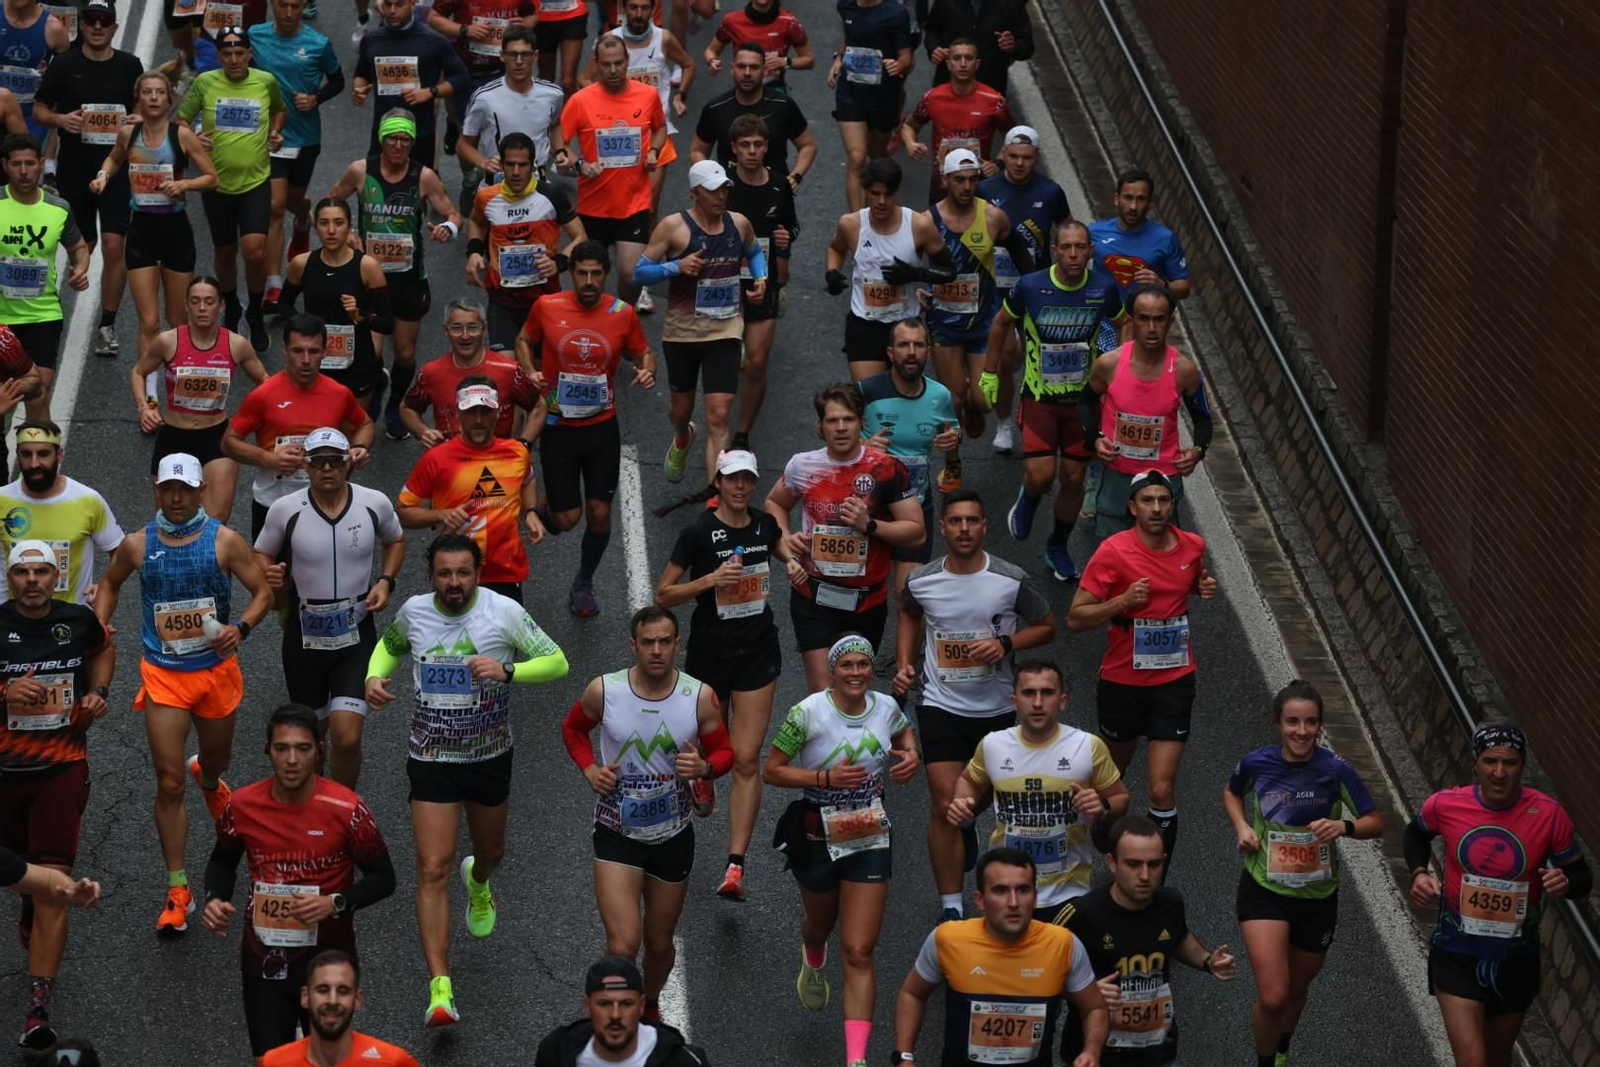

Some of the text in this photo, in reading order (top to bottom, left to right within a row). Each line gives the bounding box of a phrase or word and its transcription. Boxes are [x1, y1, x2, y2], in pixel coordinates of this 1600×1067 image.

[5, 75, 32, 87] 1630
[89, 114, 117, 126] 4064
[222, 108, 251, 121] 2575
[603, 137, 631, 150] 3372
[508, 208, 529, 218] RUN
[507, 225, 530, 235] FUN
[373, 244, 402, 256] 6122
[6, 267, 37, 280] 3089
[704, 288, 734, 301] 2432
[940, 284, 968, 296] 3713
[185, 379, 217, 391] 6328
[566, 385, 597, 399] 2545
[1120, 424, 1151, 440] 4619
[820, 538, 855, 555] 5856
[165, 613, 203, 631] 4580
[309, 614, 342, 630] 2721
[1144, 630, 1178, 646] 3057
[945, 644, 970, 660] 509
[428, 668, 466, 685] 2373
[1025, 778, 1042, 791] 59
[630, 799, 667, 819] 2388
[1279, 846, 1316, 863] 3505
[262, 899, 290, 918] 425
[1469, 891, 1511, 912] 4359
[1115, 951, 1165, 976] 100
[1122, 1003, 1158, 1025] 5541
[981, 1018, 1028, 1036] 4207
